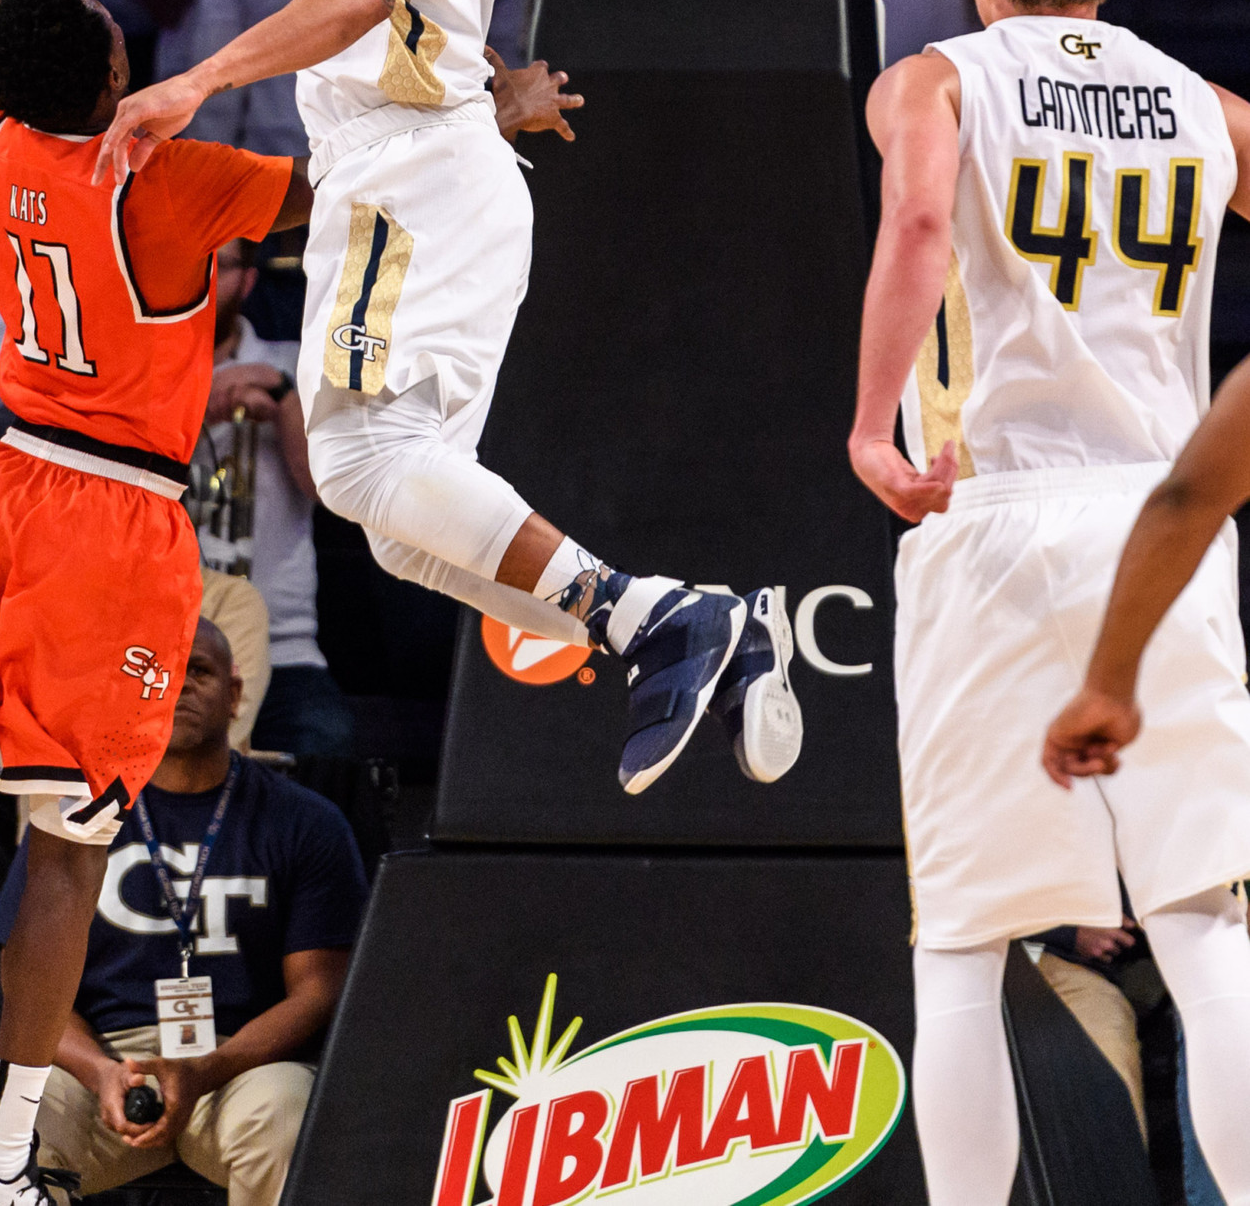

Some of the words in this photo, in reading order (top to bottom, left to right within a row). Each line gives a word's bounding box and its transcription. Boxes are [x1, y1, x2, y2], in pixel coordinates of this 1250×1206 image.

[1059, 33, 1102, 60] GT
[1018, 75, 1178, 140] LAMMERS
[9, 183, 48, 226] KATS
[1003, 150, 1205, 318] 44
[4, 228, 98, 378] 11
[331, 322, 387, 362] GT
[96, 841, 269, 955] GT
[430, 1037, 869, 1206] LIBMAN
